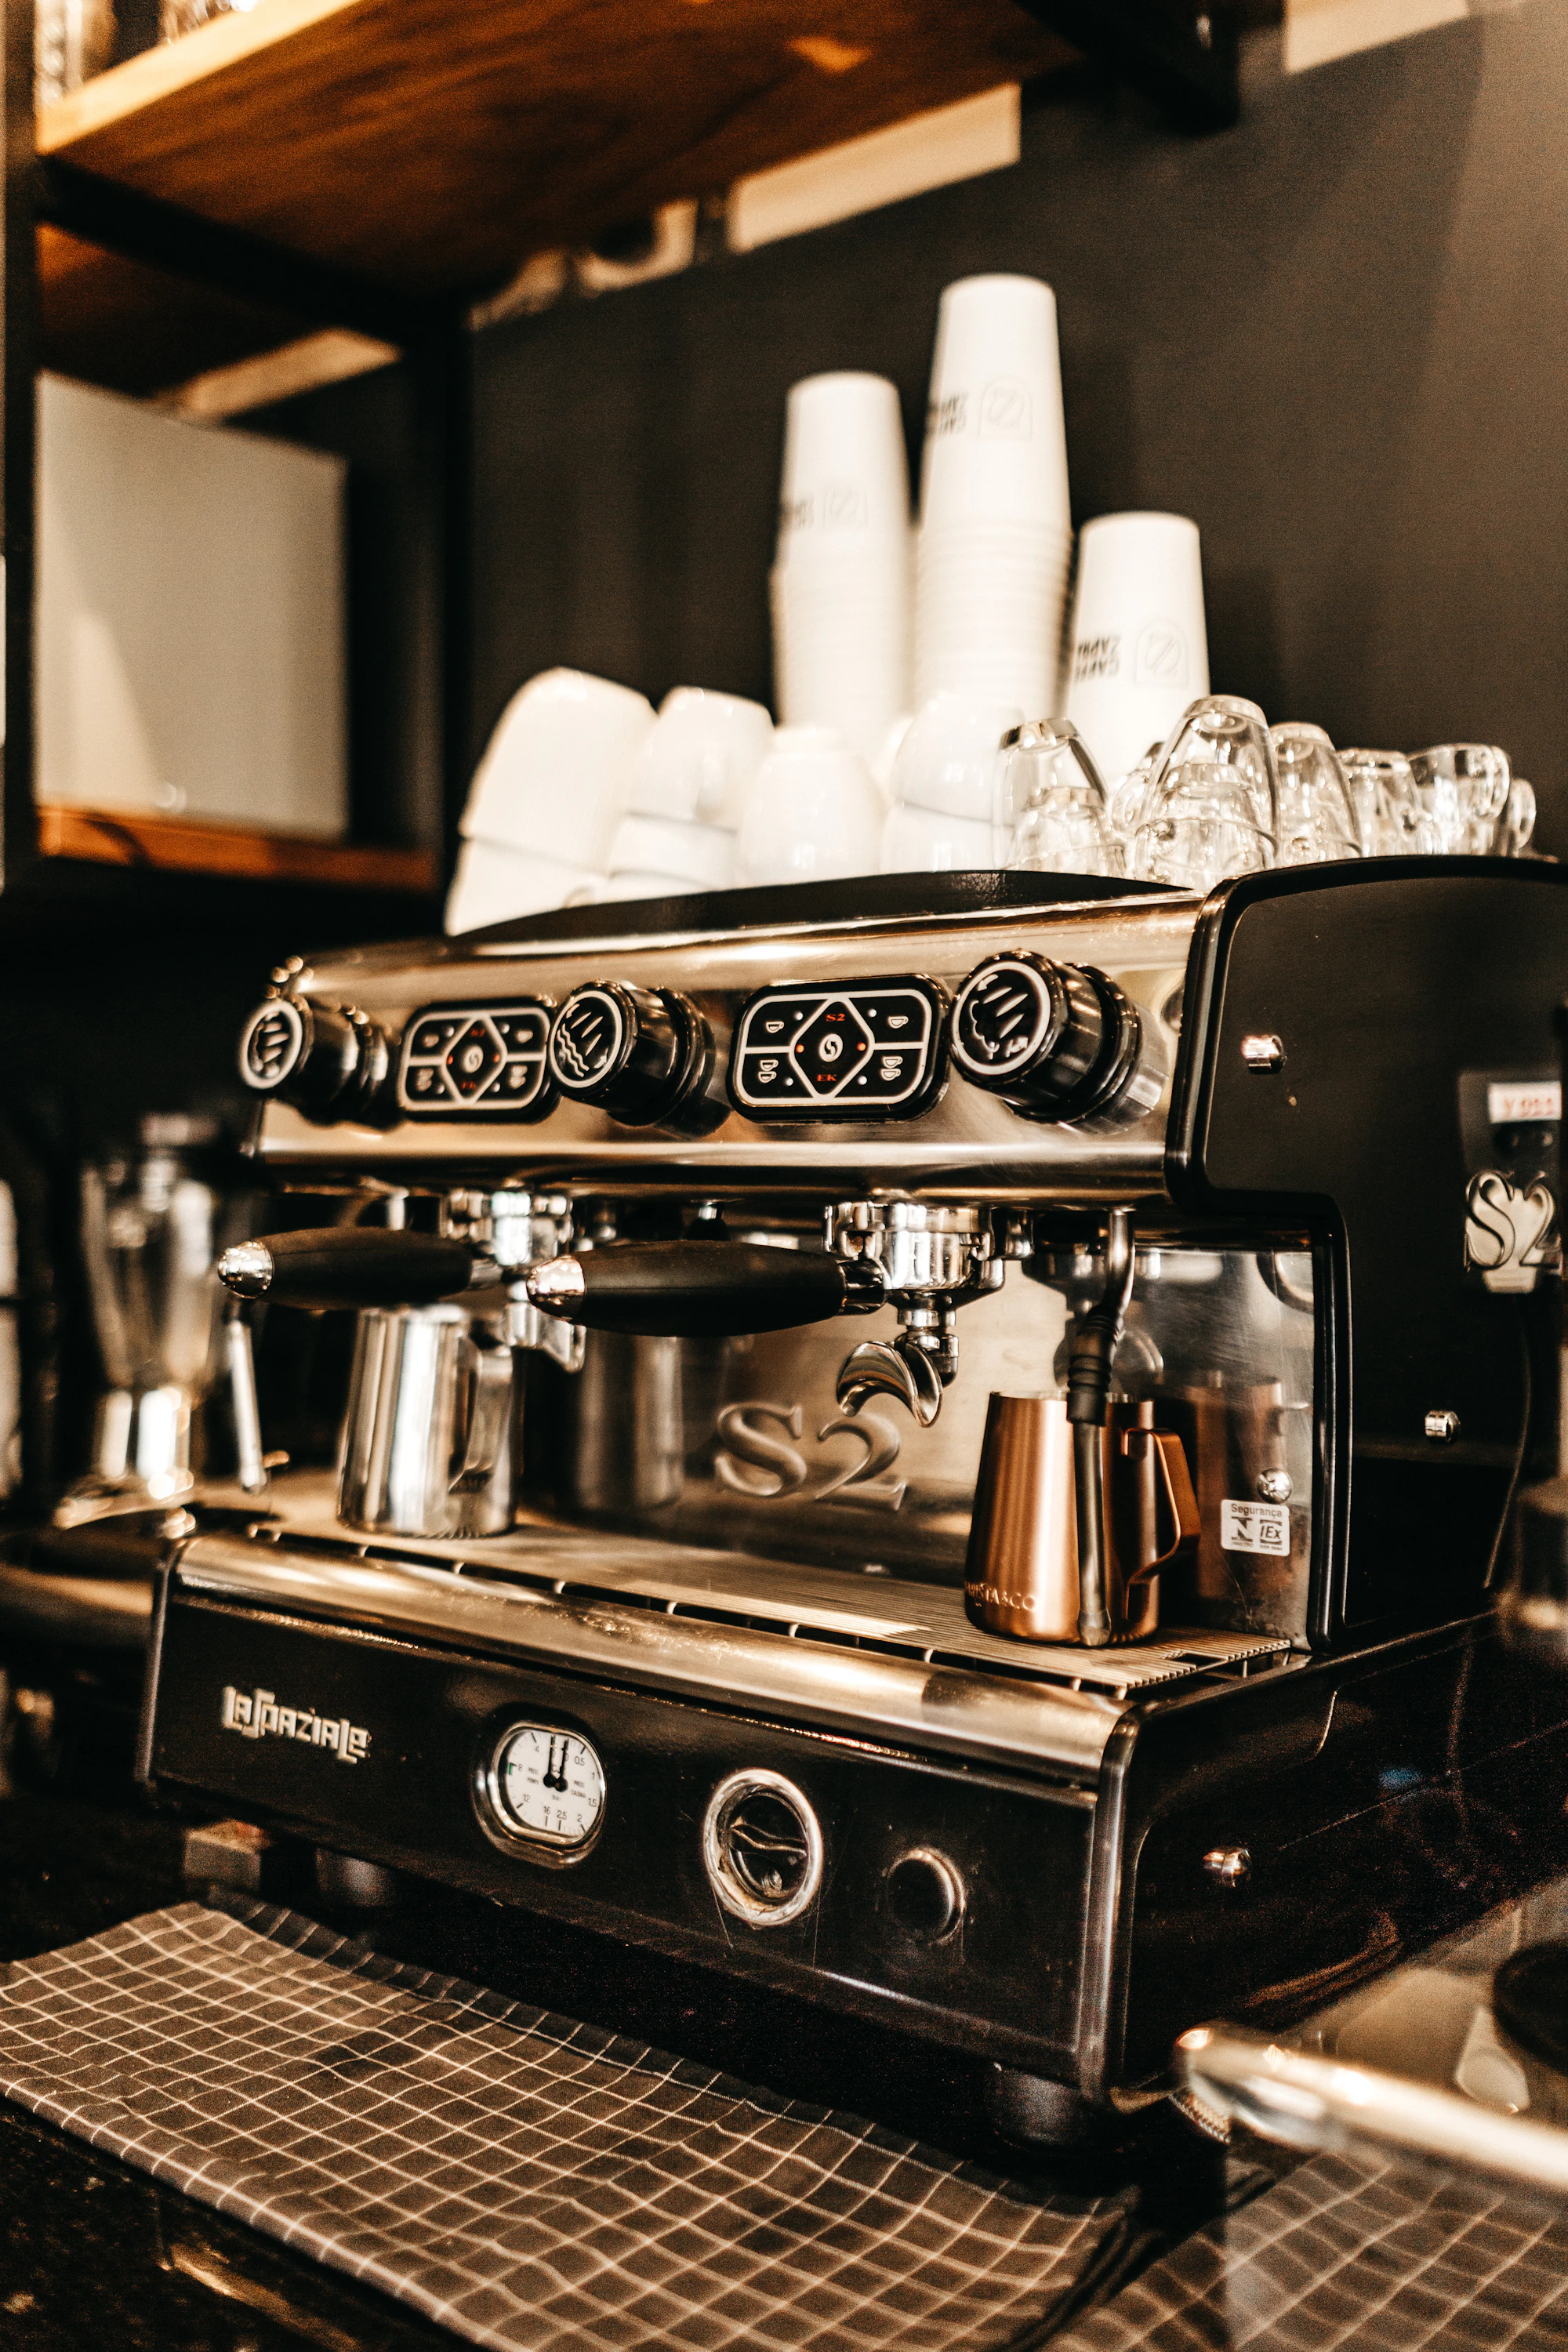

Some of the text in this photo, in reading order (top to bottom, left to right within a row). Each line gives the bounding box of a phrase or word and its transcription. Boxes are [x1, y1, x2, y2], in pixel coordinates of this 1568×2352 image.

[826, 1012, 846, 1022] S2
[816, 1073, 838, 1083] EK
[714, 1401, 906, 1512] S2
[1231, 1503, 1283, 1519] Segurança
[518, 1763, 524, 1772] 8
[523, 1794, 531, 1803] 12
[543, 1806, 551, 1815] 16
[577, 1813, 583, 1822] 2
